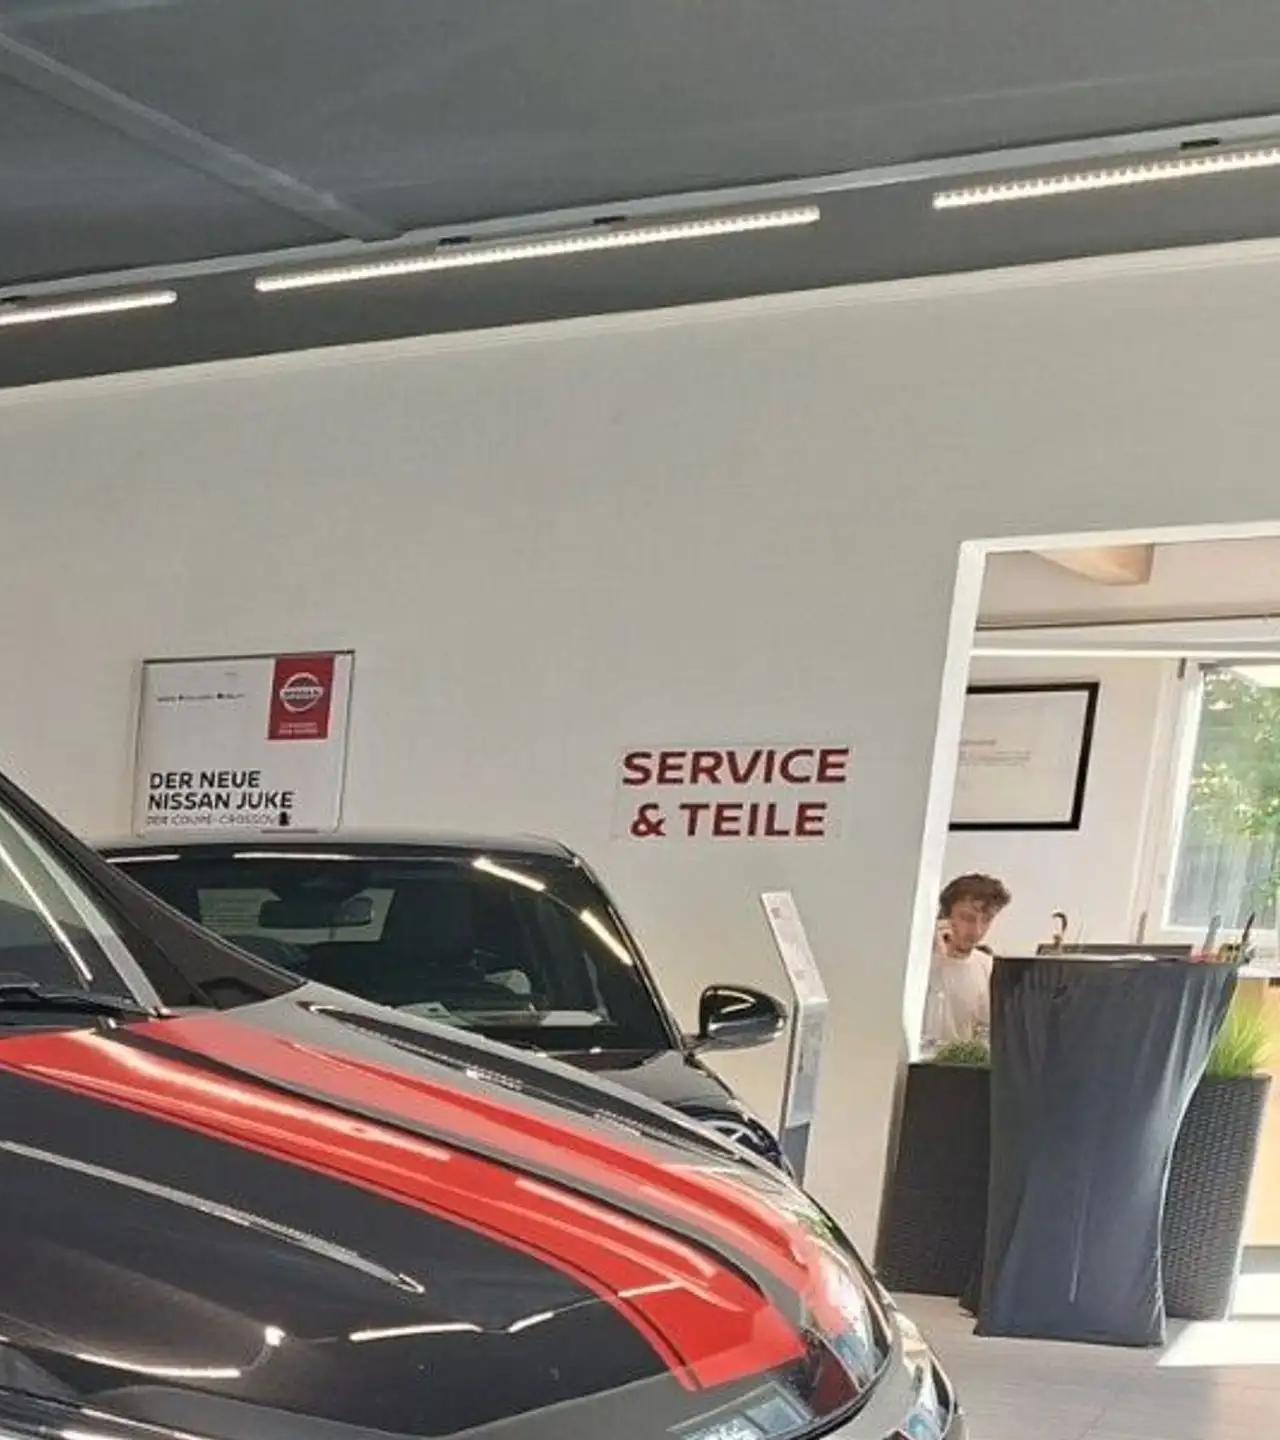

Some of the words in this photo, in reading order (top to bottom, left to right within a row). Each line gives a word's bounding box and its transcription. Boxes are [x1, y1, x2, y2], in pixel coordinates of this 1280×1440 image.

[149, 771, 192, 790] DER
[198, 770, 261, 789] NEUE
[622, 746, 850, 786] SERVICE
[147, 792, 231, 811] NISSAN
[235, 791, 296, 810] JUKE
[630, 802, 667, 837] &
[678, 801, 828, 838] TEILE
